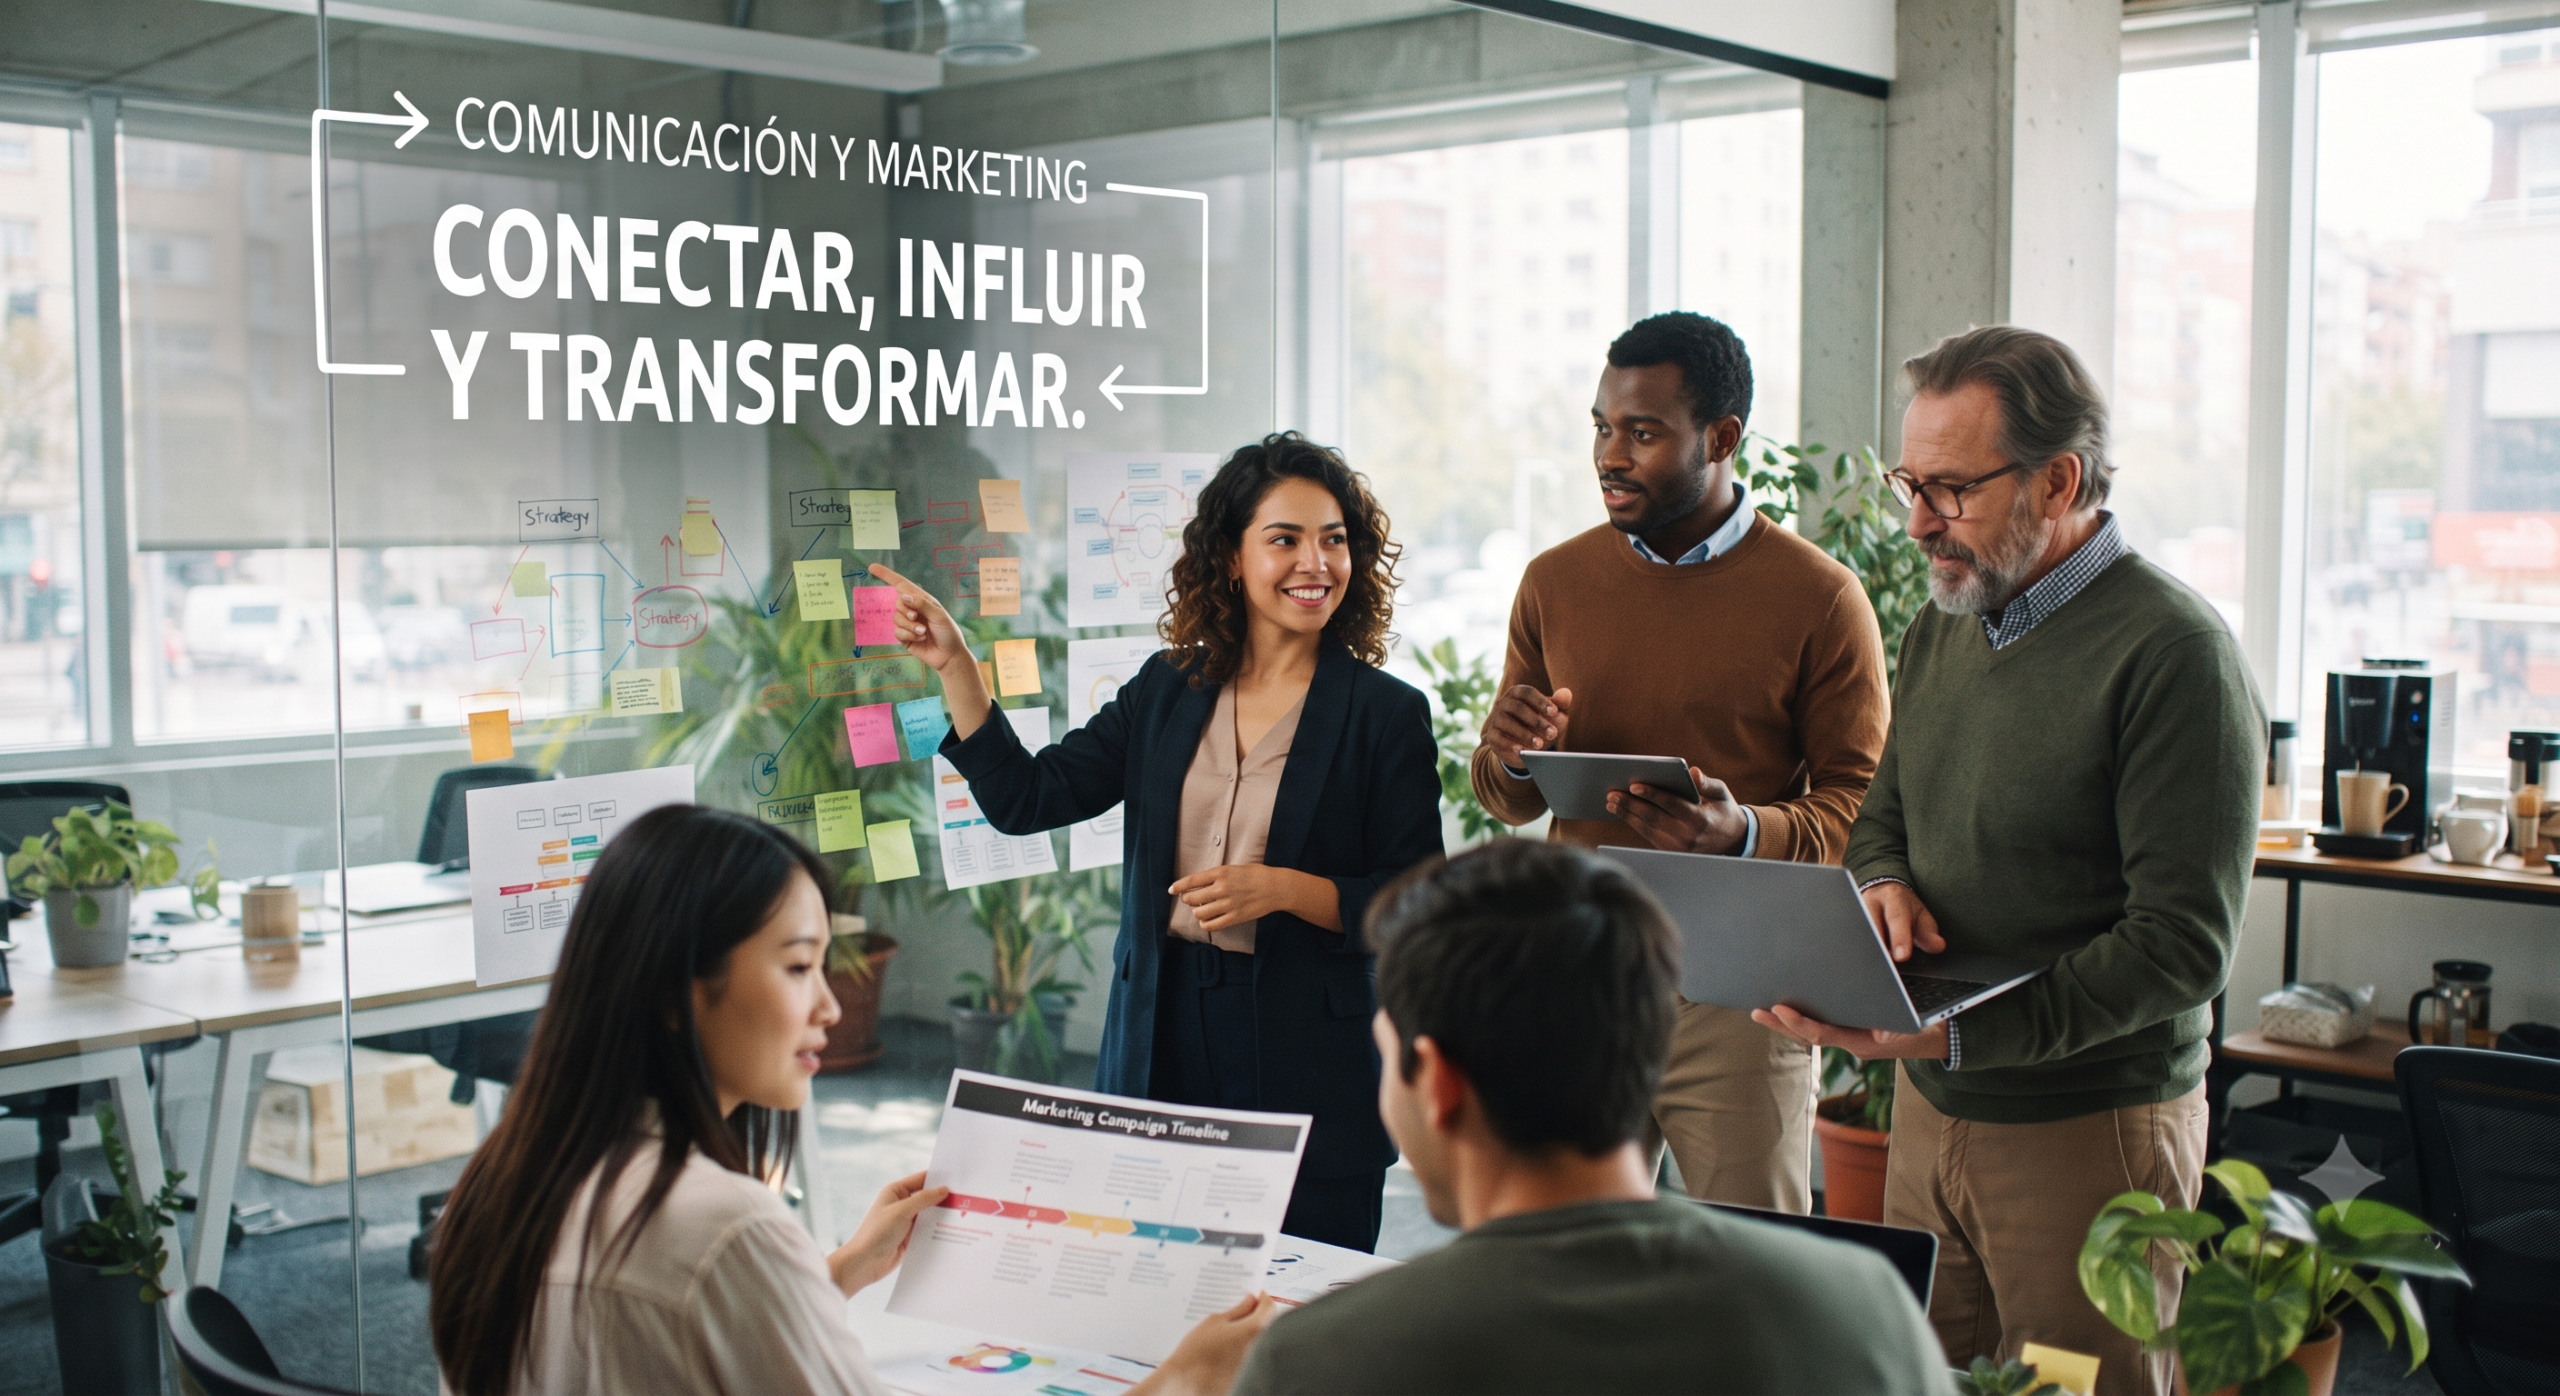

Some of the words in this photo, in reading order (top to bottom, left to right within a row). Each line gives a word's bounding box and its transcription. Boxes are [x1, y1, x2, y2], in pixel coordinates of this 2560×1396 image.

[525, 506, 590, 531] Strategy
[800, 496, 851, 523] Strateg
[639, 607, 699, 631] Strategy
[1022, 1098, 1094, 1126] Marketing
[1097, 1111, 1168, 1137] Campaign
[1171, 1120, 1230, 1141] Timeline
